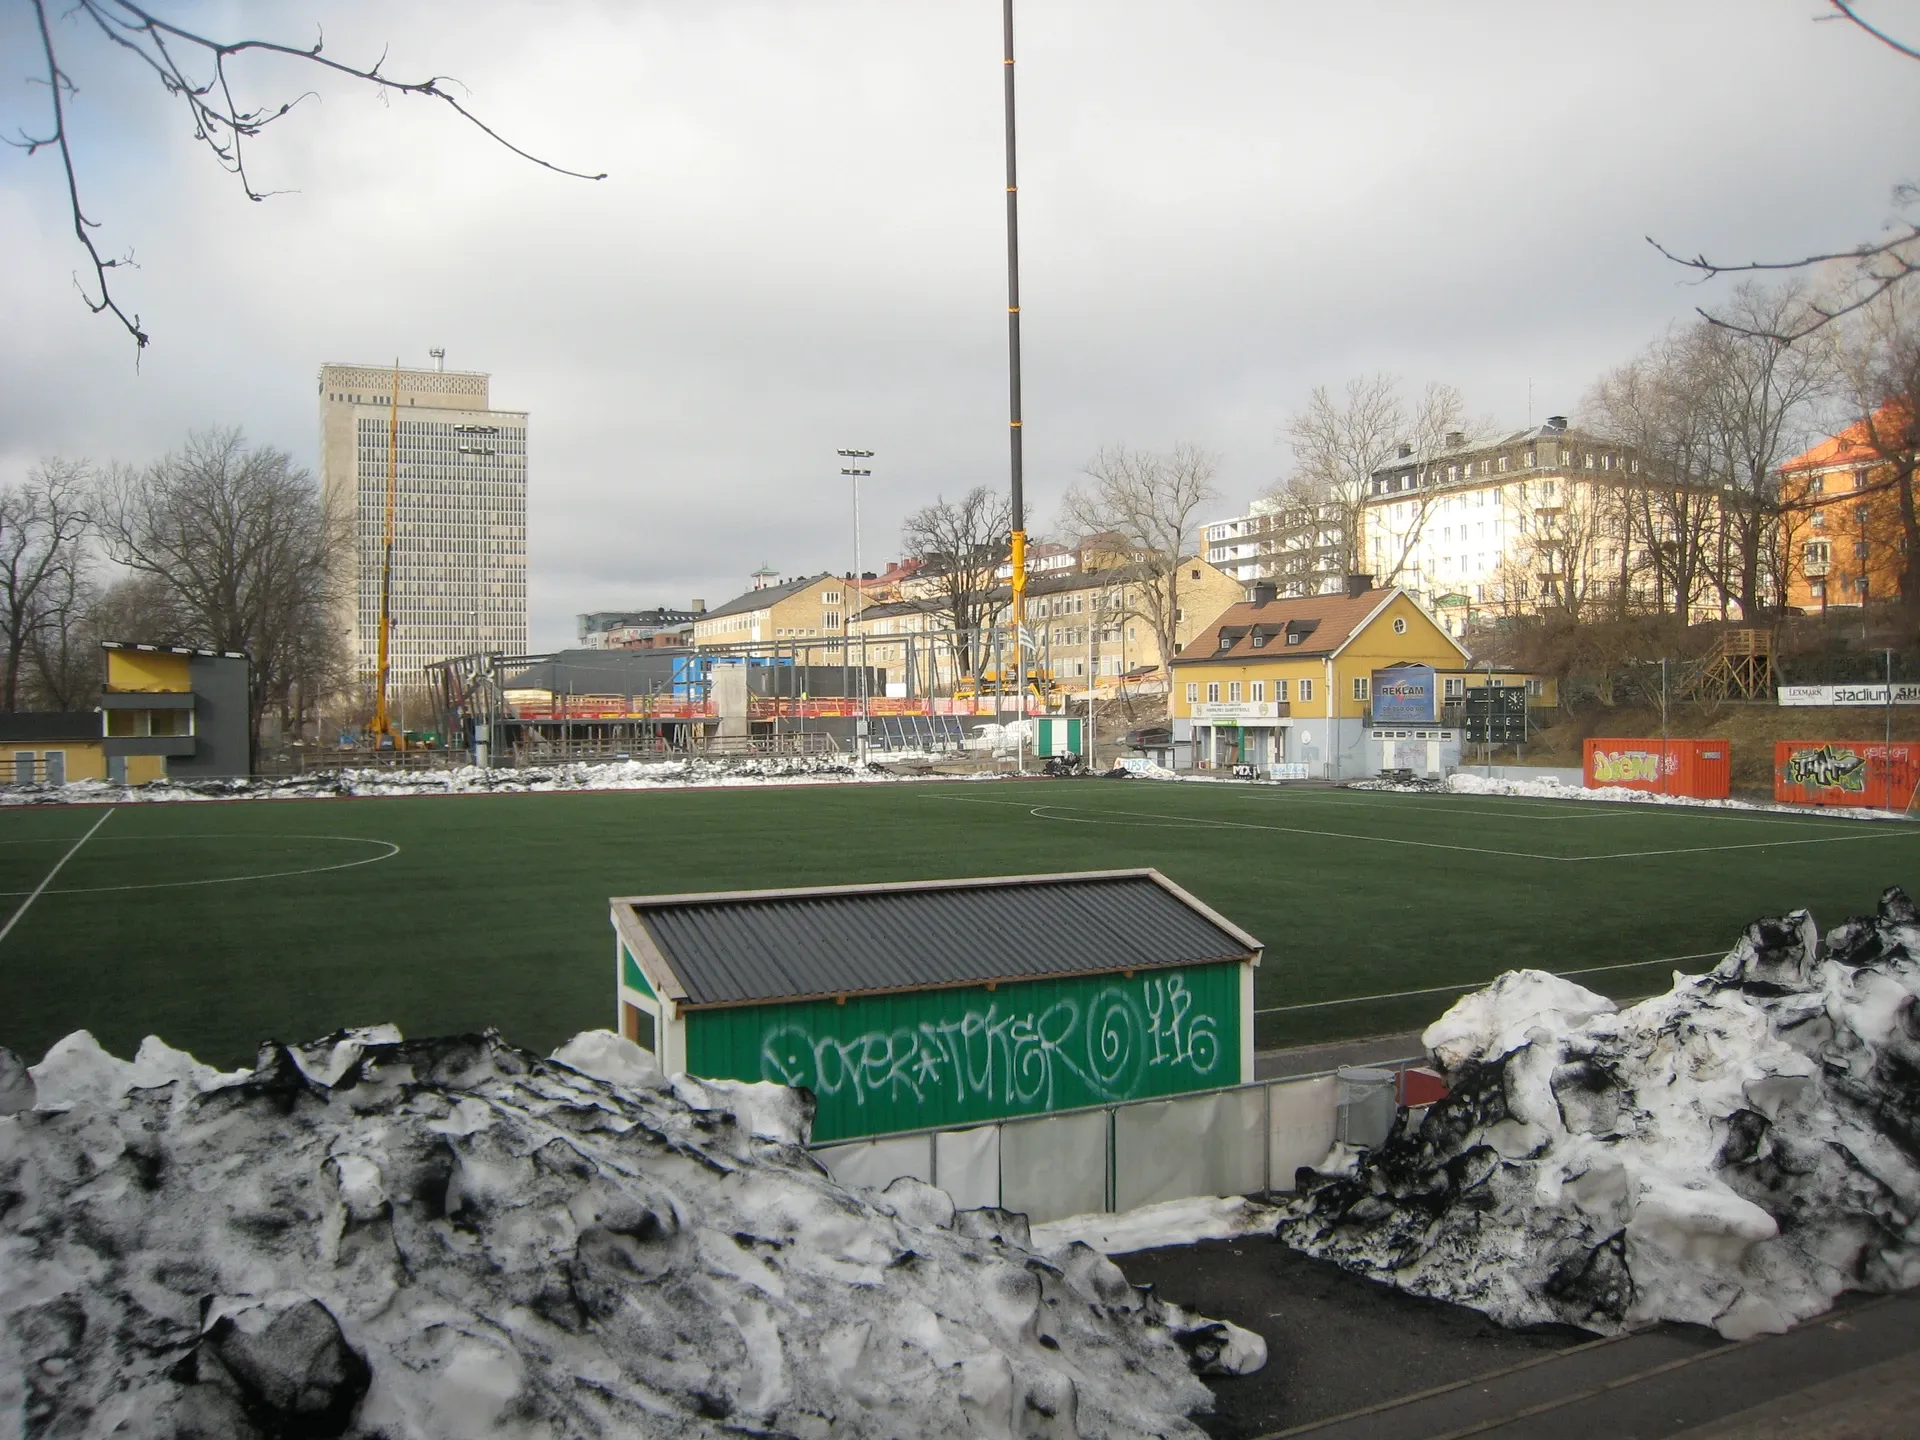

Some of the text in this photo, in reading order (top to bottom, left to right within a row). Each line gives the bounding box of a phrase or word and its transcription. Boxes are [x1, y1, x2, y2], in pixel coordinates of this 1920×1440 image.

[1382, 687, 1424, 695] REKLAM
[1834, 688, 1891, 702] stadium
[1898, 687, 1920, 697] SH
[1466, 717, 1472, 726] A
[1505, 717, 1511, 726] E
[1505, 731, 1511, 740] F
